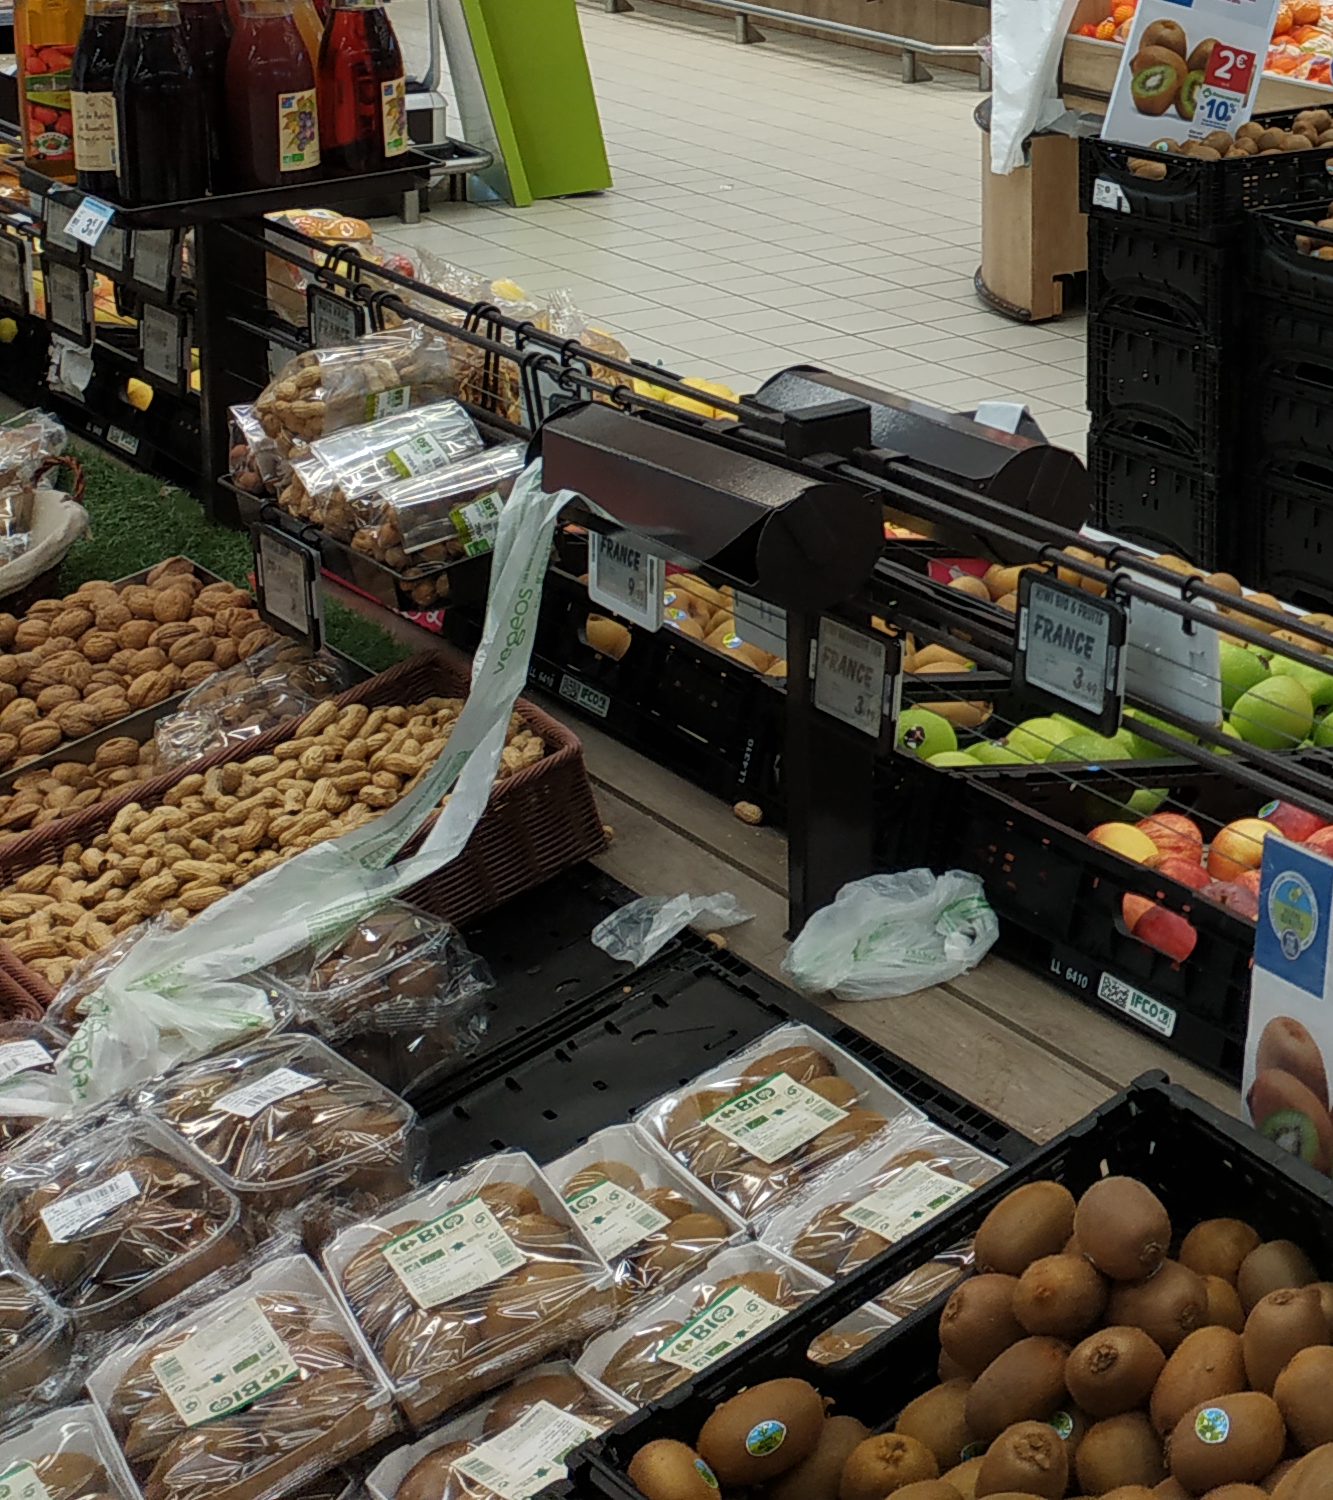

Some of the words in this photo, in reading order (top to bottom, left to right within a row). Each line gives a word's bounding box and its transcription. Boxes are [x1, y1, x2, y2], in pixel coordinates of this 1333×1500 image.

[600, 536, 641, 571] FRANCE
[493, 586, 533, 676] vegeos
[1033, 614, 1095, 660] FRANCE
[822, 646, 873, 688] FRANCE
[581, 687, 599, 703] IFCO
[1051, 959, 1061, 974] LL
[1066, 968, 1088, 988] 6410
[1130, 992, 1158, 1018] IFCO
[734, 1087, 775, 1112] BIO
[417, 1213, 464, 1243] BIO
[690, 1304, 734, 1340] BIO
[209, 1380, 261, 1413] BIO
